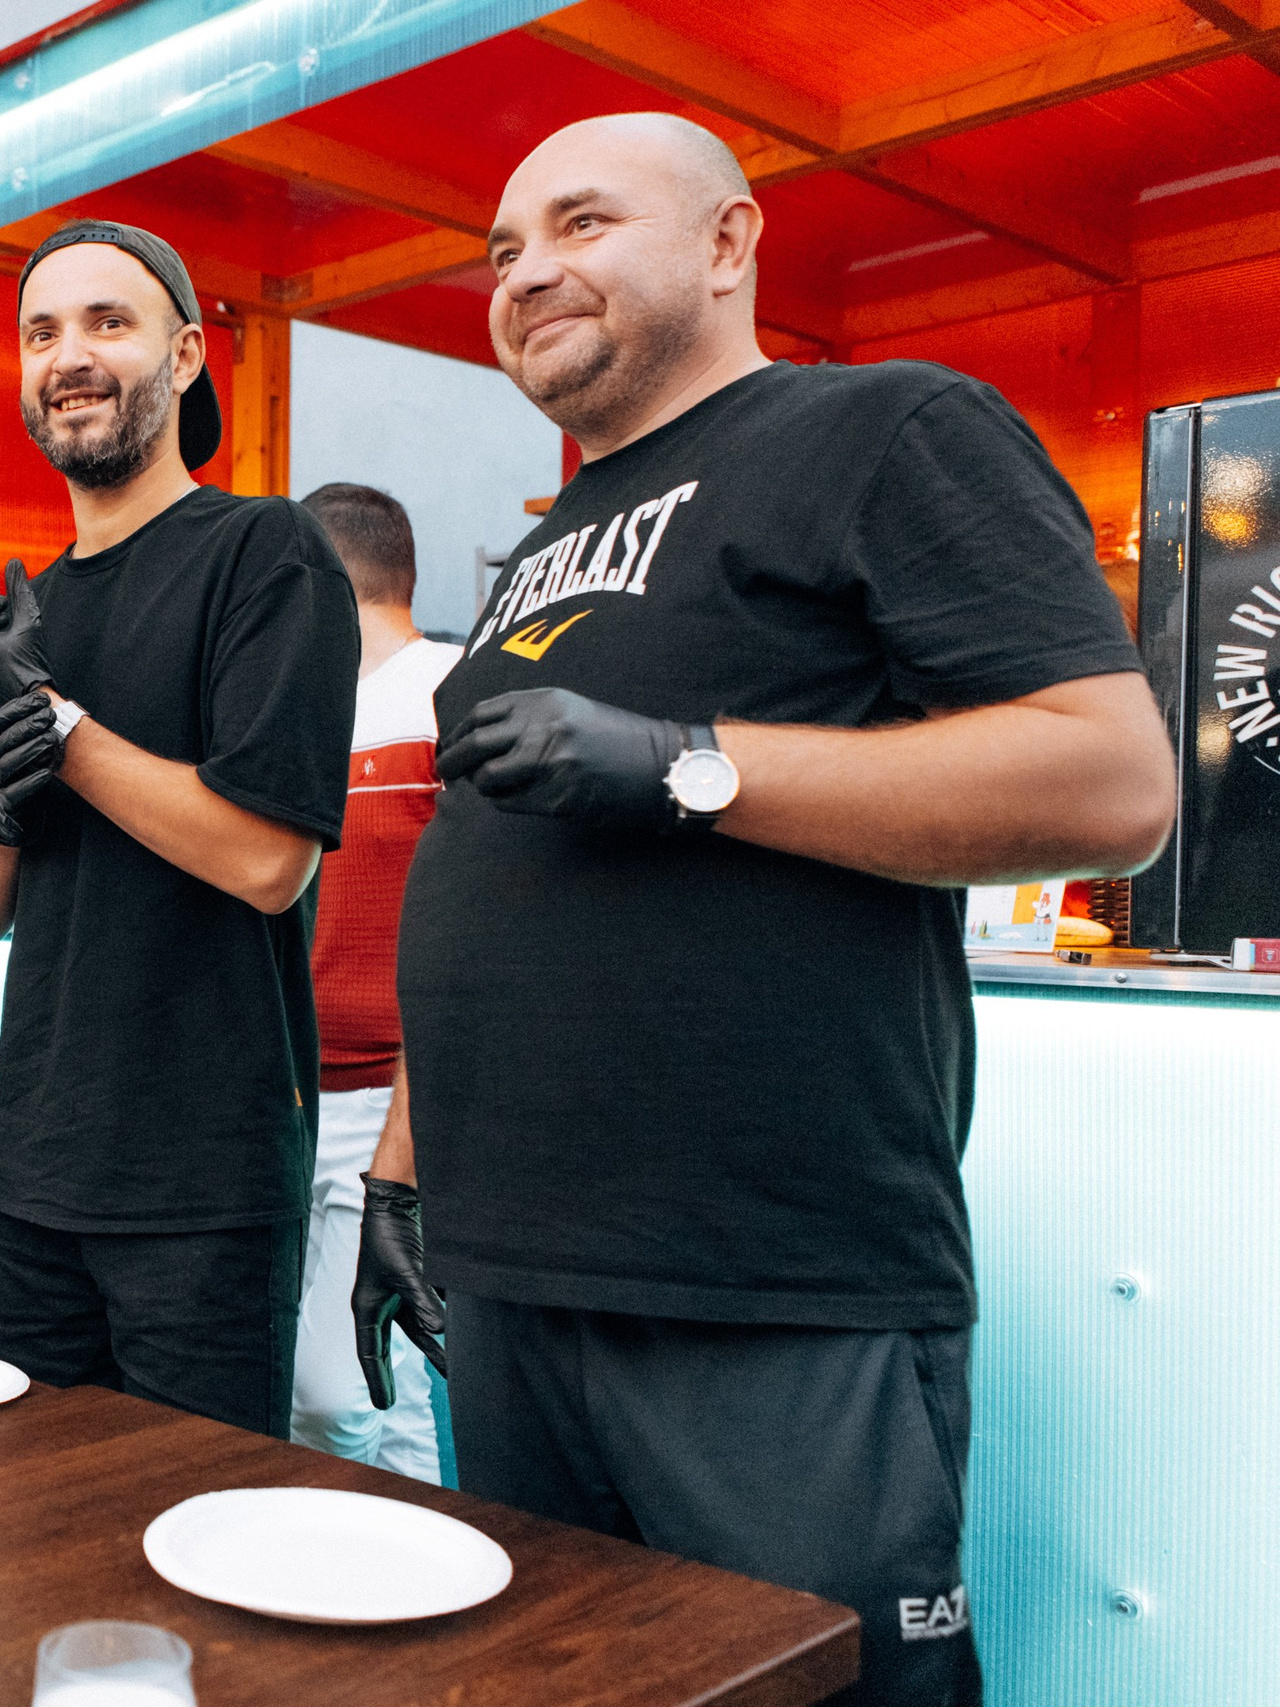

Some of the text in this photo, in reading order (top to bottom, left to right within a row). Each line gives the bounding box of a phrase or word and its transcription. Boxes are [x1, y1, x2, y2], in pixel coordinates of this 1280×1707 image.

[468, 480, 700, 659] EVERLAST
[1213, 566, 1280, 744] NEW RI
